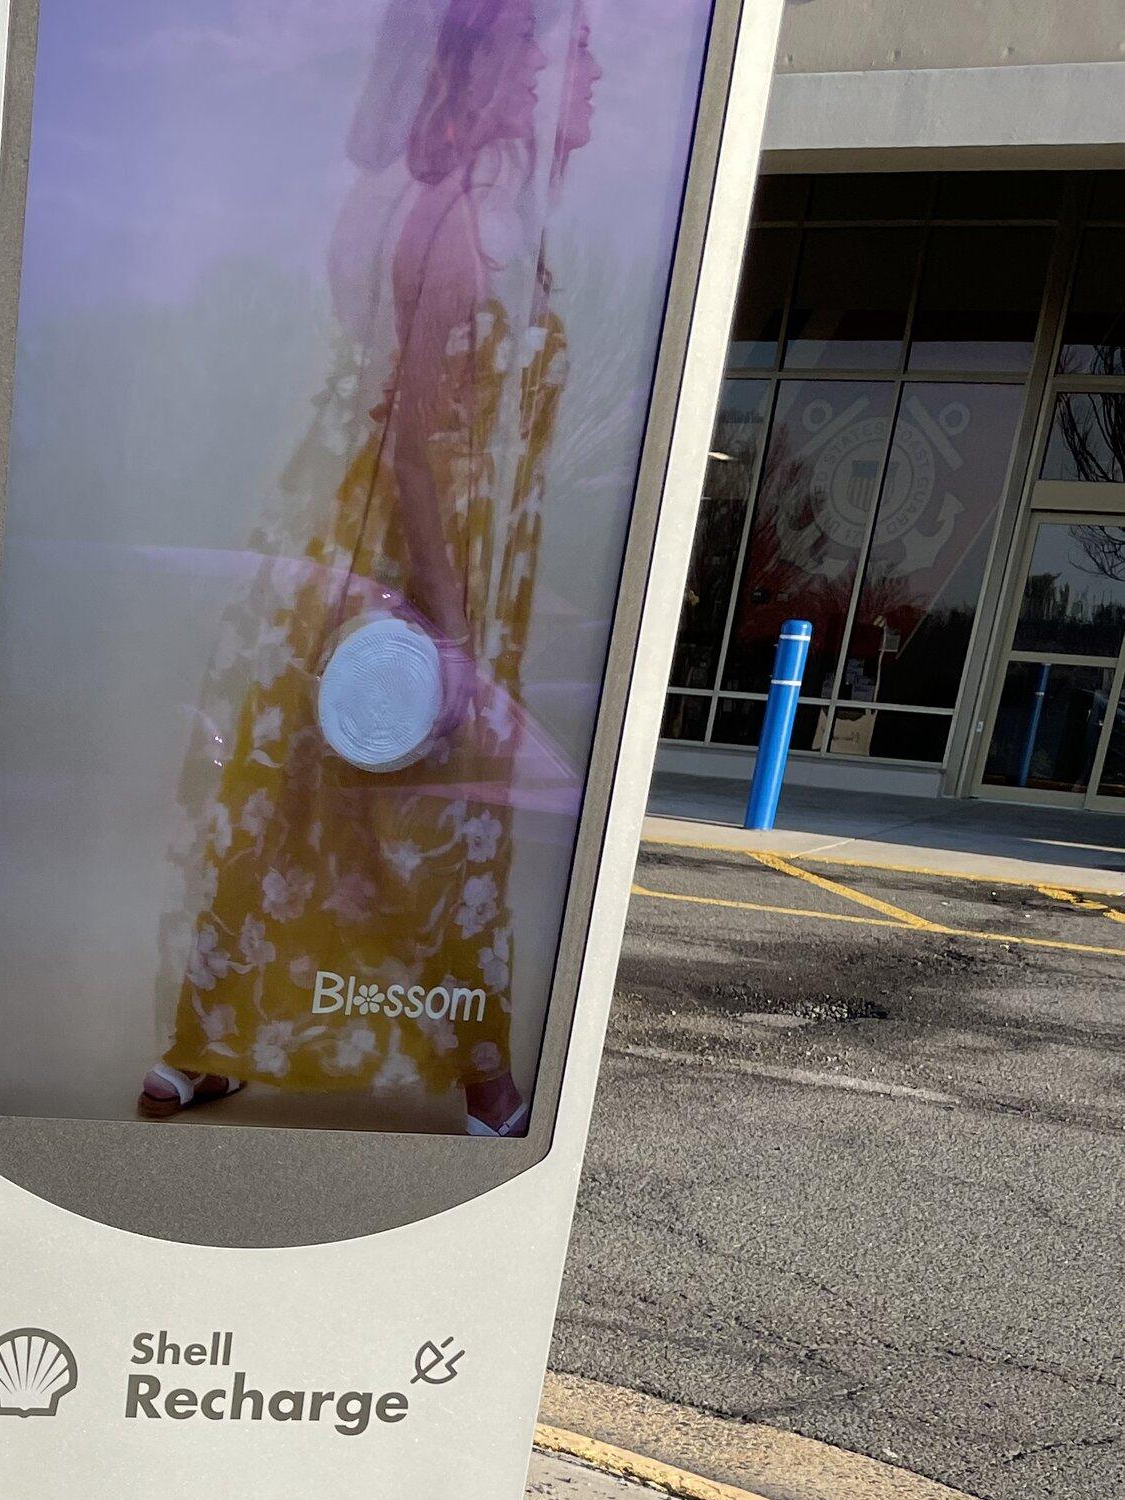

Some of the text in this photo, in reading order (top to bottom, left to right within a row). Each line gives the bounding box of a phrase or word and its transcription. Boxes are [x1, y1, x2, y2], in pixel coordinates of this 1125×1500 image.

[822, 421, 885, 466] STATES
[886, 475, 930, 535] GUARD
[311, 970, 487, 1022] Blossom
[130, 1330, 234, 1366] Shell
[124, 1371, 410, 1436] Recharge
